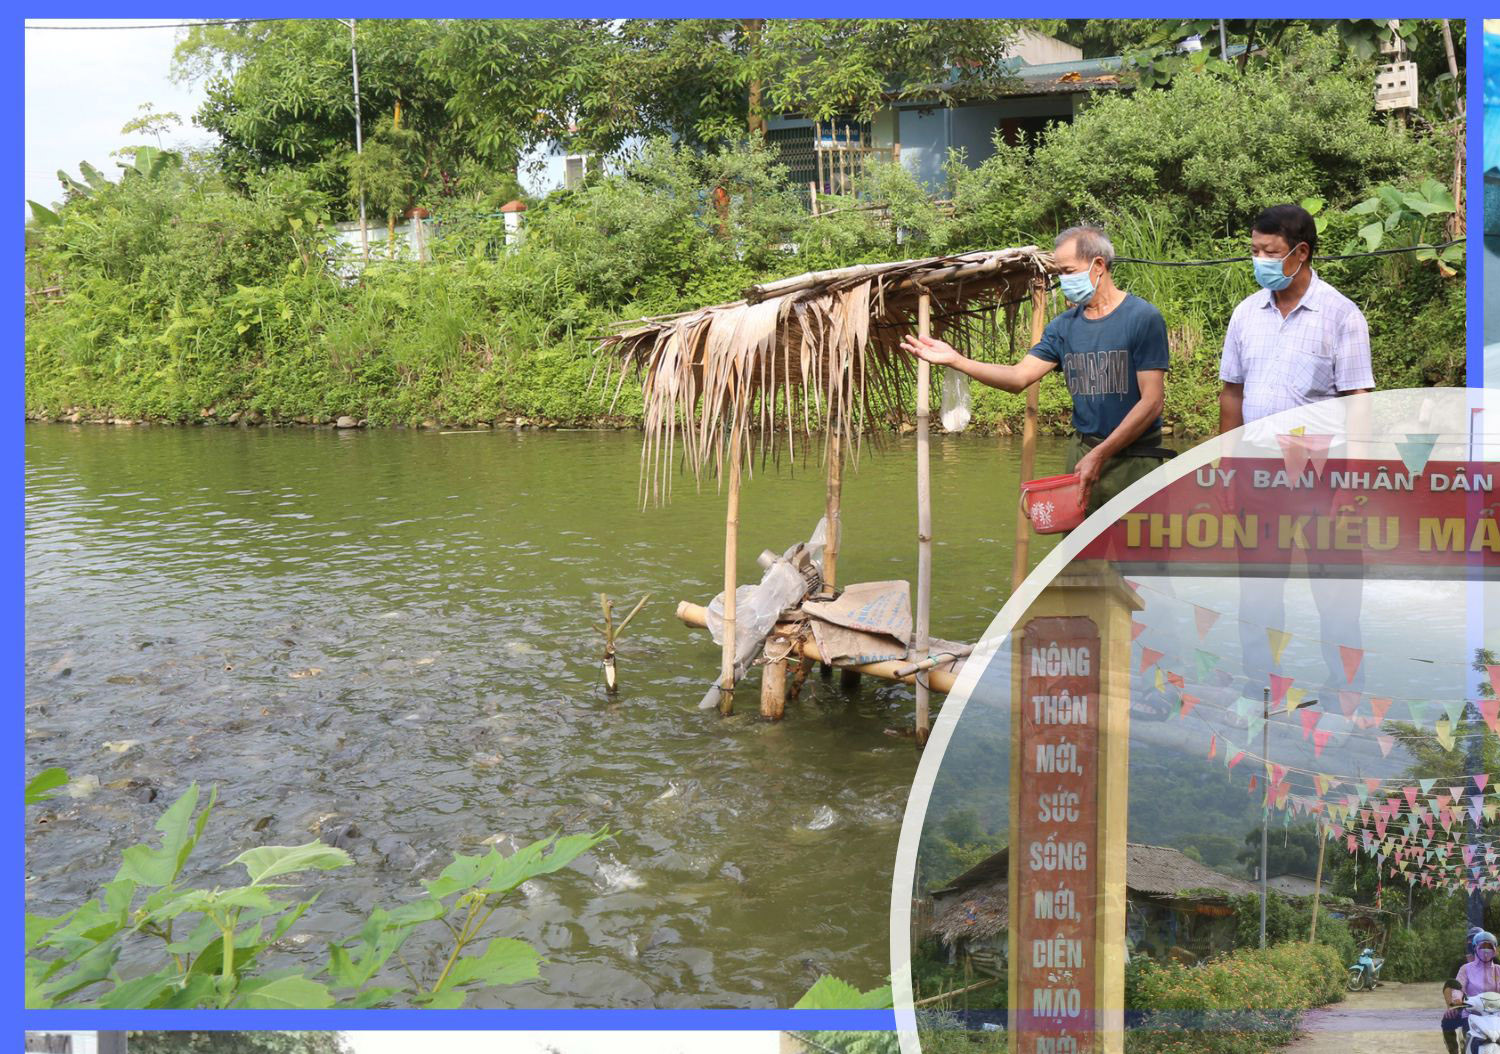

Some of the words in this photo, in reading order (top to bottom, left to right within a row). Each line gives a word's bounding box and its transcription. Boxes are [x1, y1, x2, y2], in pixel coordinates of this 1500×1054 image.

[1064, 350, 1128, 397] CHARM
[1253, 469, 1315, 490] BAN
[1330, 466, 1415, 491] NHÂN
[1430, 466, 1493, 492] DÂN
[1119, 503, 1259, 549] THÔN
[1278, 496, 1400, 551] KIỂU
[1031, 641, 1090, 677] NÔNG
[1031, 689, 1088, 725] THÔN
[1035, 736, 1083, 777] MỚI,
[1038, 785, 1080, 823] SỨC
[1029, 832, 1087, 871] SỐNG
[1034, 881, 1081, 923] MỚI,
